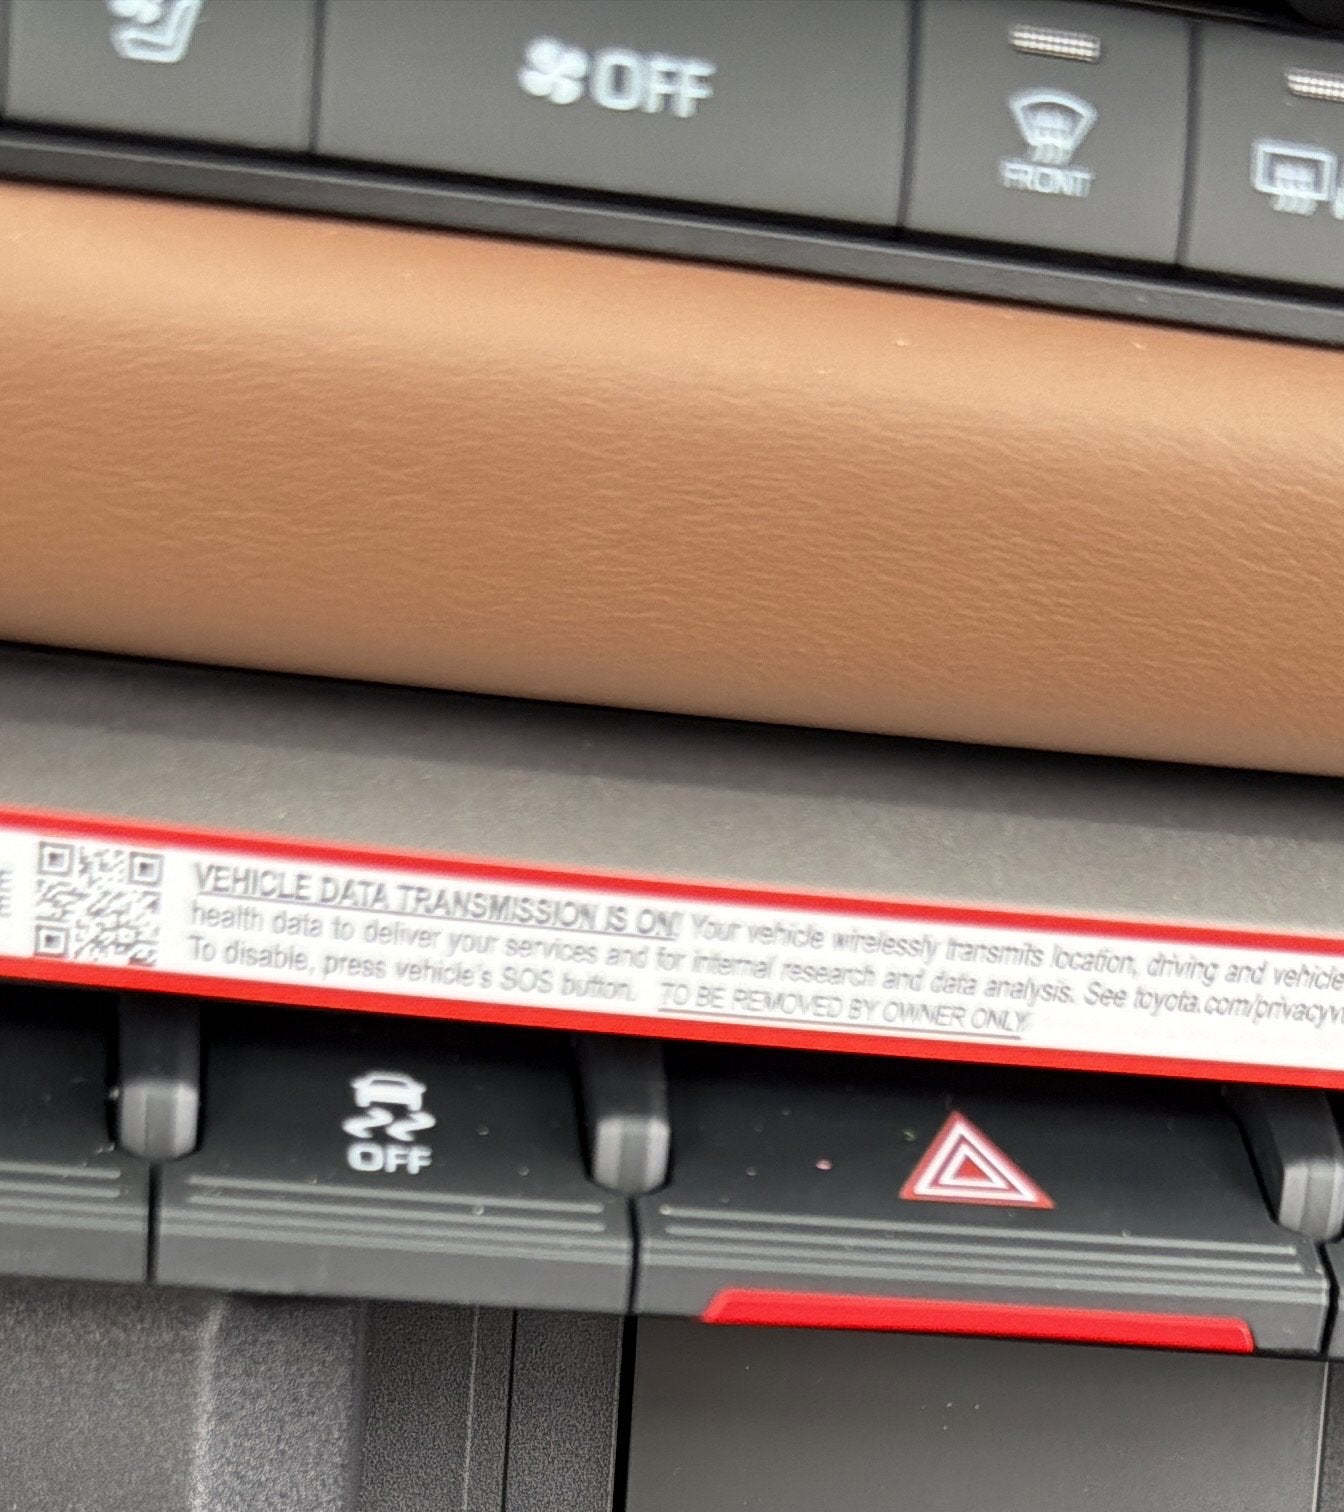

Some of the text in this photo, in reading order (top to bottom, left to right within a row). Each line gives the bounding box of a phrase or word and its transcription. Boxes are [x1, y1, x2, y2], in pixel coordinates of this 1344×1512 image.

[591, 48, 716, 117] OFF
[1000, 158, 1094, 198] FRONT
[194, 861, 311, 901] VEHICLE
[318, 876, 388, 909] DATA
[398, 884, 597, 930] TRANSMISSION
[606, 905, 628, 933] IS
[691, 912, 741, 942] Your
[748, 919, 825, 949] vehicle
[832, 927, 939, 965] wirelessly
[945, 936, 1044, 968] transmits
[1147, 952, 1219, 987] driving
[1225, 960, 1265, 986] and
[188, 935, 216, 962] To
[323, 952, 387, 980] press
[395, 957, 493, 989] vehicle's
[500, 965, 554, 995] SOS
[191, 902, 264, 932] health
[272, 910, 323, 938] data
[331, 915, 355, 941] to
[364, 918, 443, 949] deliver
[447, 933, 499, 958] your
[505, 936, 599, 965] services
[607, 943, 648, 970] and
[655, 946, 687, 973] for
[782, 956, 878, 988] research
[882, 967, 924, 994] and
[930, 970, 976, 997] data
[1083, 980, 1127, 1009] See
[659, 980, 690, 1006] TO
[696, 985, 725, 1010] BE
[732, 988, 843, 1018] REMOVED
[848, 997, 879, 1021] BY
[883, 1000, 966, 1029] OWNER
[347, 1142, 433, 1175] OFF
